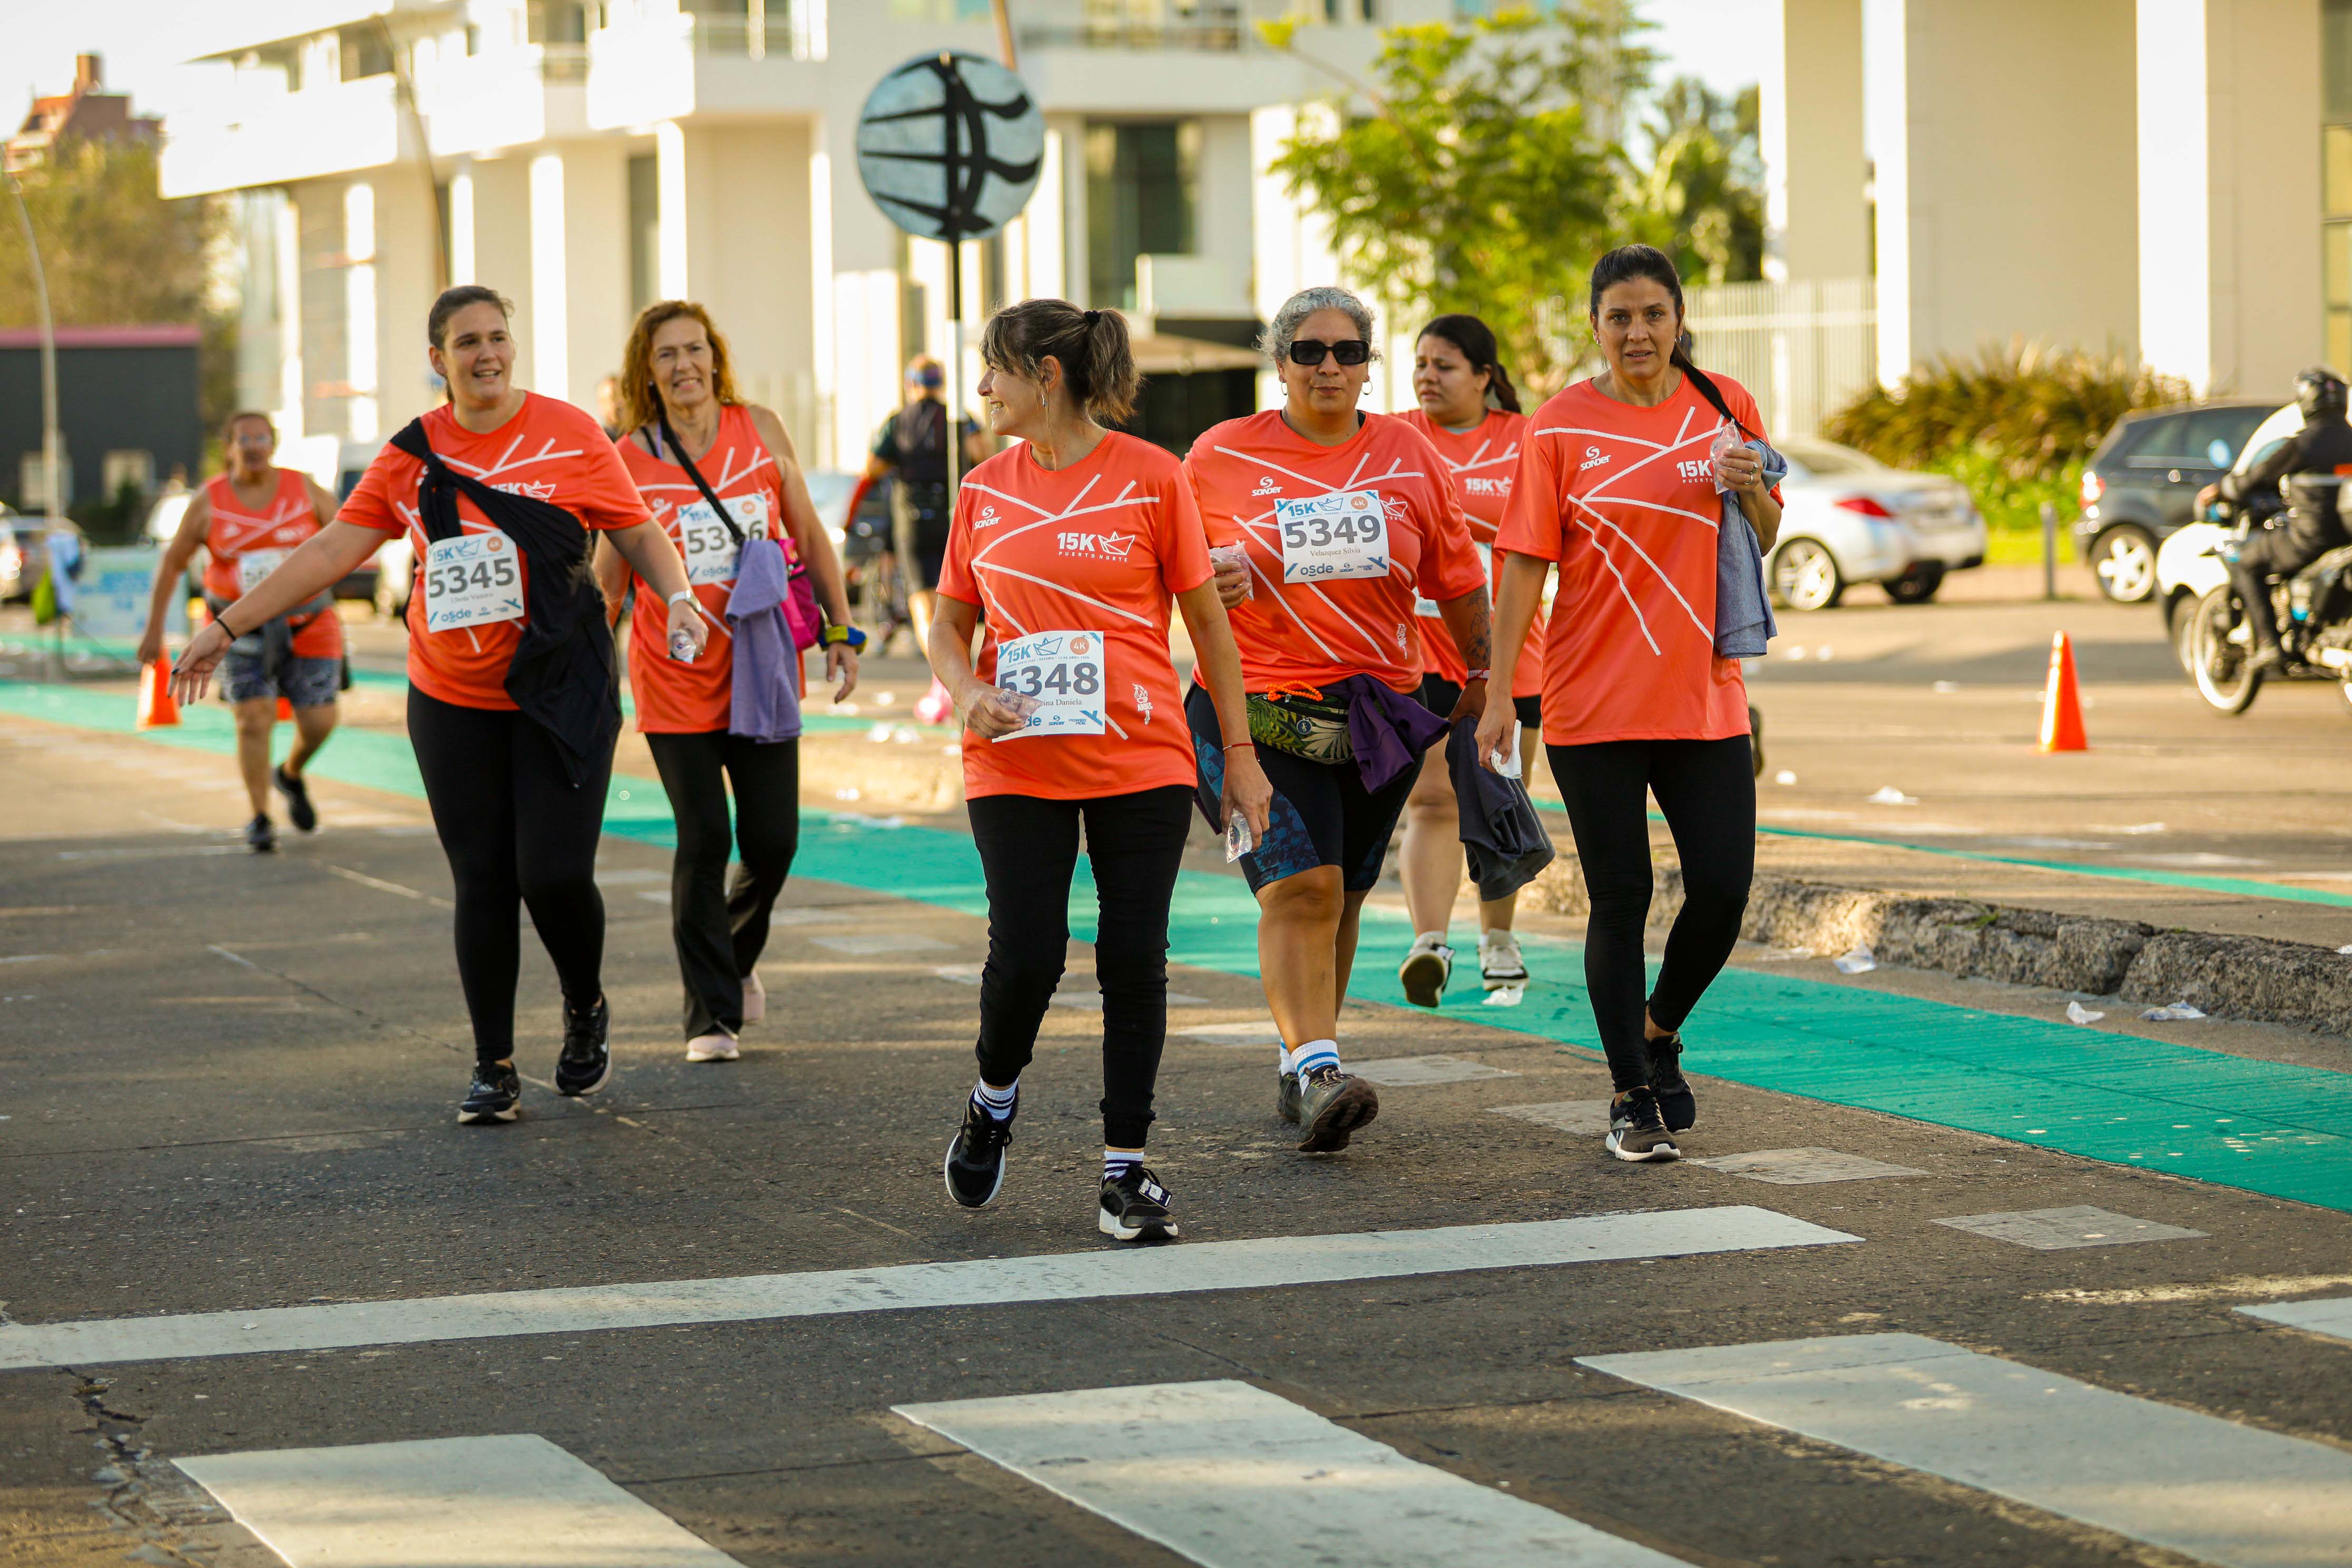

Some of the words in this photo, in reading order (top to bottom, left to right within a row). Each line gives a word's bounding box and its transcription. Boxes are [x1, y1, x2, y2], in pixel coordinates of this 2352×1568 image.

[1677, 459, 1712, 477] 15K
[1464, 477, 1494, 492] 15K
[1288, 502, 1316, 517] 15K
[687, 520, 763, 554] 536
[1285, 515, 1380, 548] 5349
[1057, 532, 1096, 552] 15K
[1343, 546, 1361, 555] Silvia
[433, 547, 455, 563] 15K
[429, 557, 515, 598] 5345
[1300, 563, 1334, 576] osde
[442, 609, 472, 623] osde
[1007, 644, 1031, 663] 15K
[1073, 642, 1085, 650] 4K
[999, 662, 1099, 698] 5348
